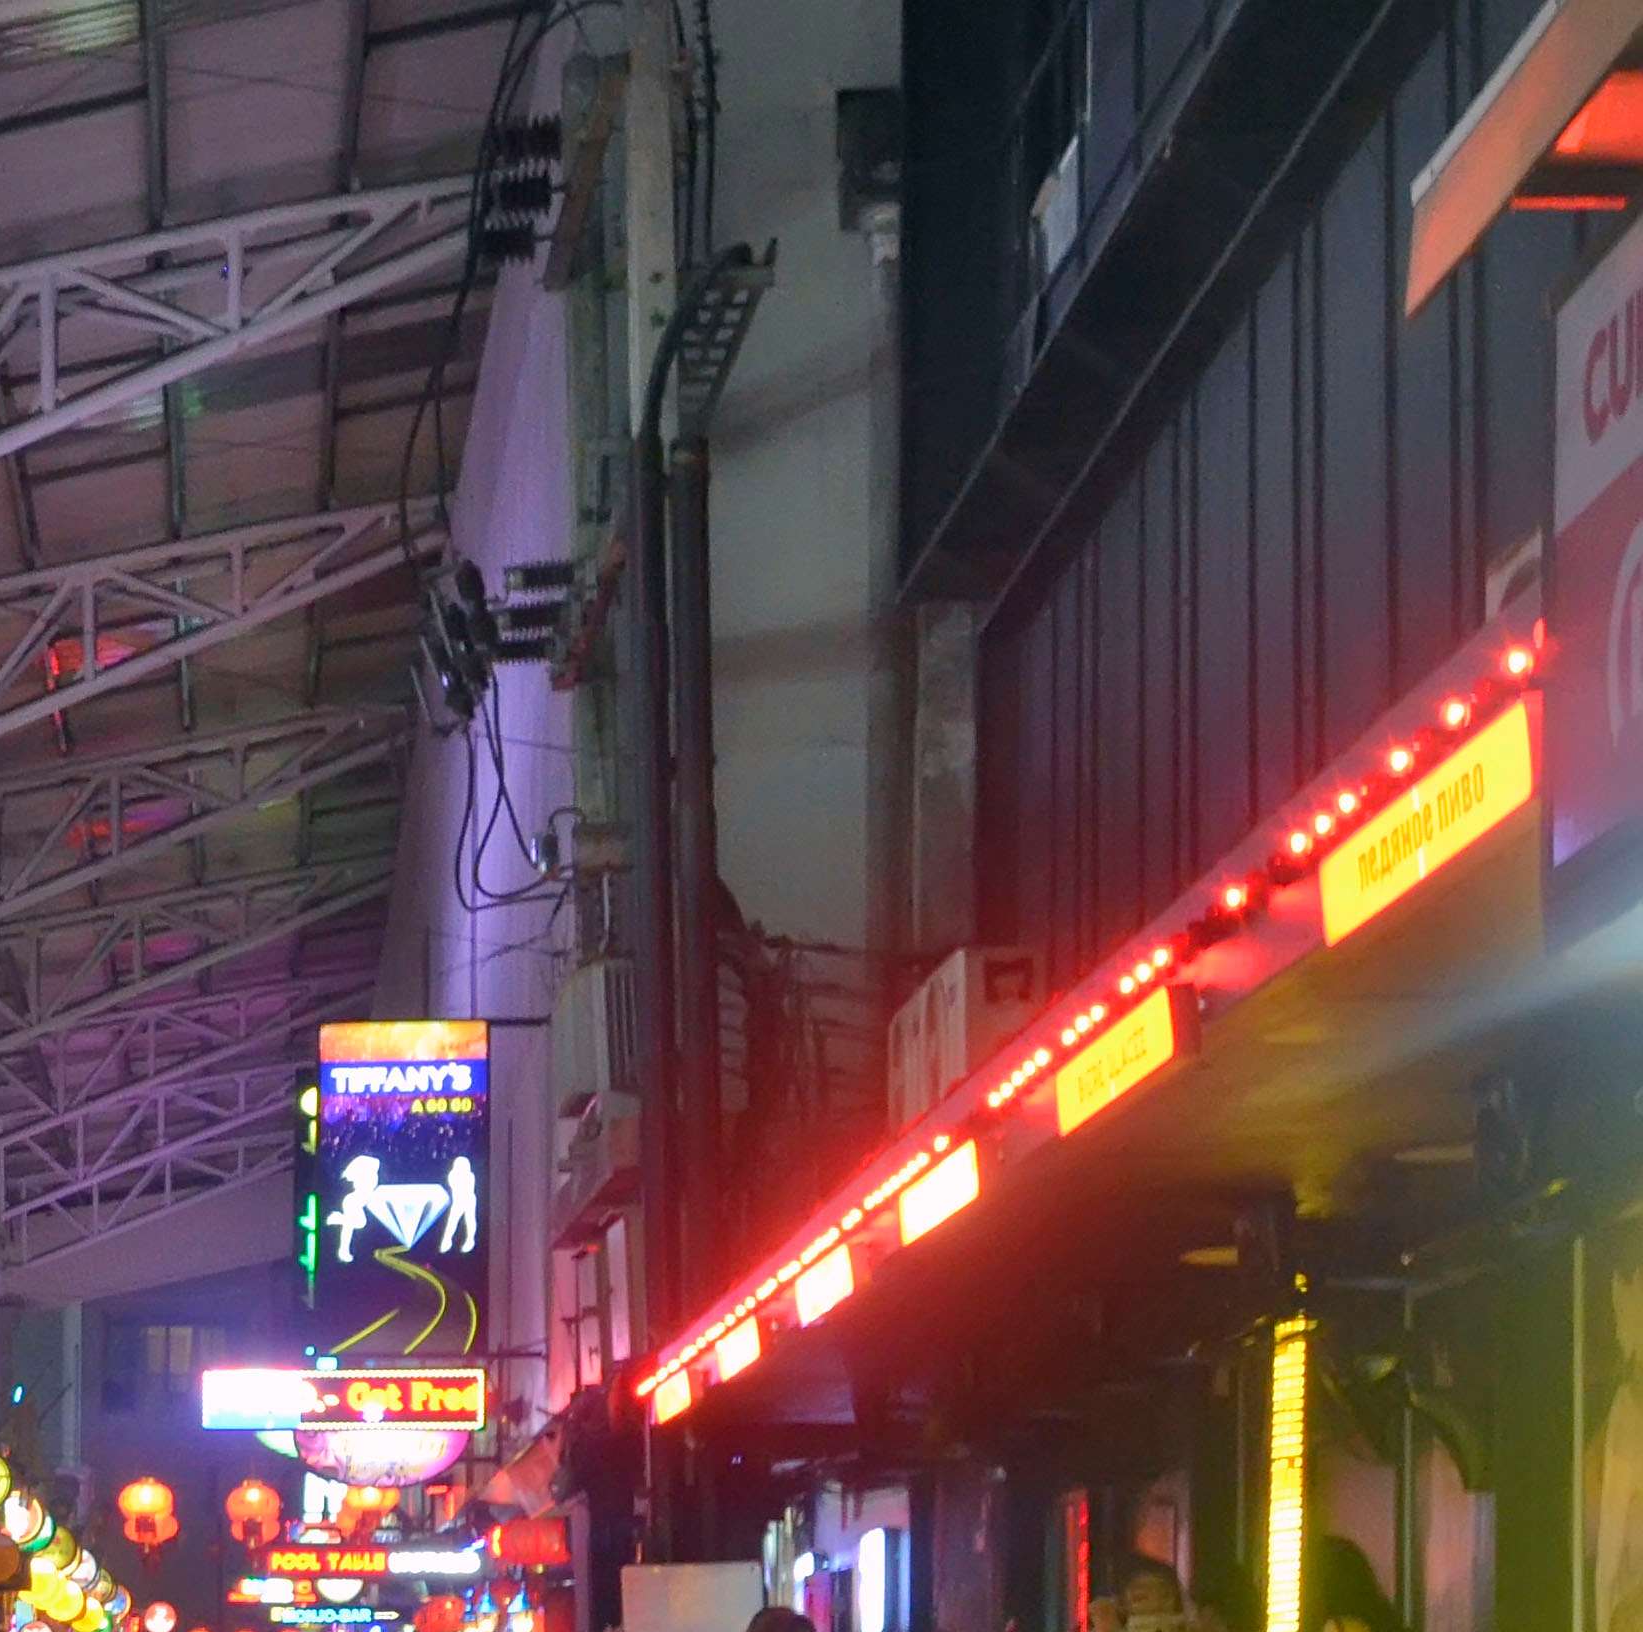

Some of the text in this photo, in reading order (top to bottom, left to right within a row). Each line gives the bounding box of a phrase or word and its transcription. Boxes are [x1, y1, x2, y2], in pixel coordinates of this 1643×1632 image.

[329, 1062, 472, 1094] TIFFANY'S
[271, 1551, 321, 1571] POOL
[327, 1551, 386, 1571] TABLE
